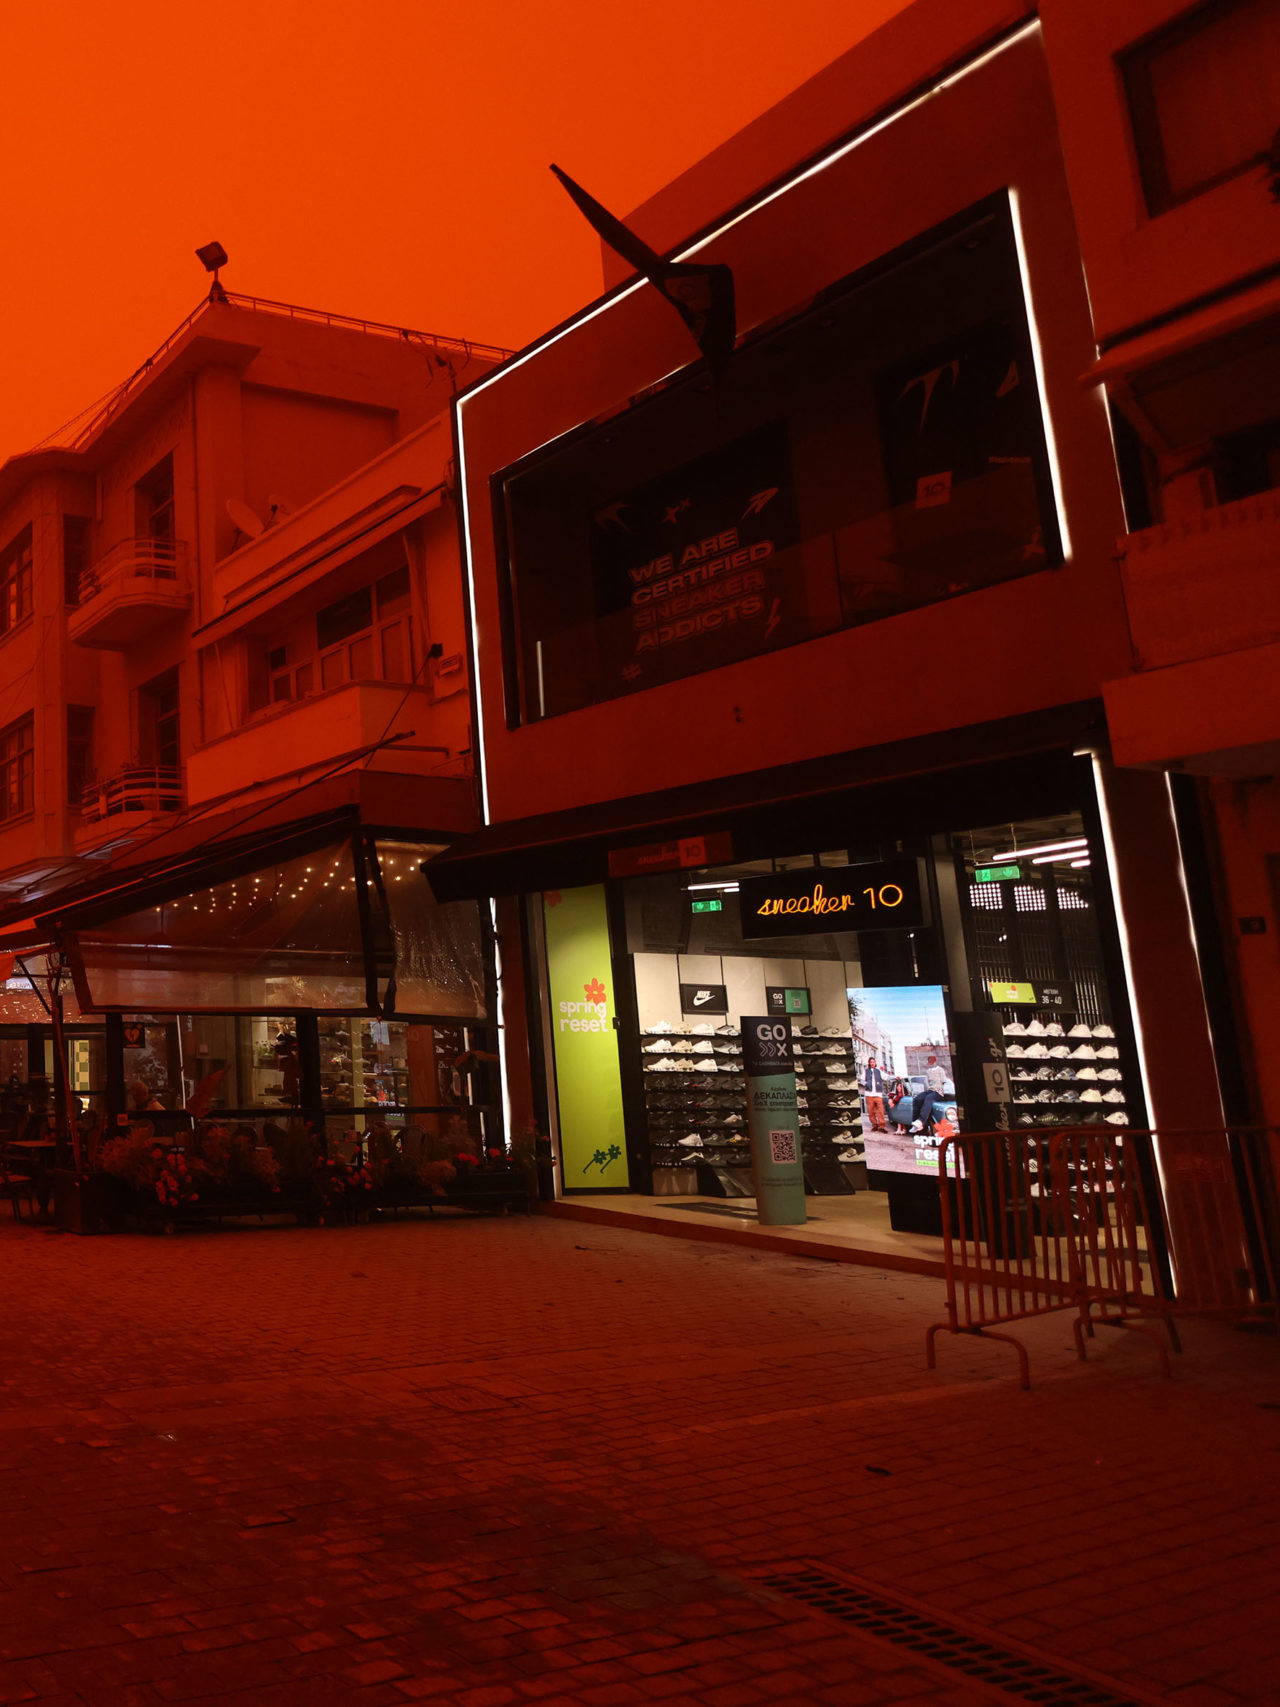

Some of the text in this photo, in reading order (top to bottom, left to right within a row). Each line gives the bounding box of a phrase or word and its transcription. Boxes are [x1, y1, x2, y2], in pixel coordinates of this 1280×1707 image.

[627, 527, 739, 584] WE ARE
[631, 540, 775, 605] CERTIFIED
[632, 568, 765, 630] SNEAKER
[634, 594, 763, 656] ADDICTS
[756, 884, 903, 915] sneaker 10
[560, 998, 607, 1018] spring
[560, 1017, 609, 1032] reset
[756, 1024, 786, 1041] GO
[992, 1069, 1004, 1096] 10
